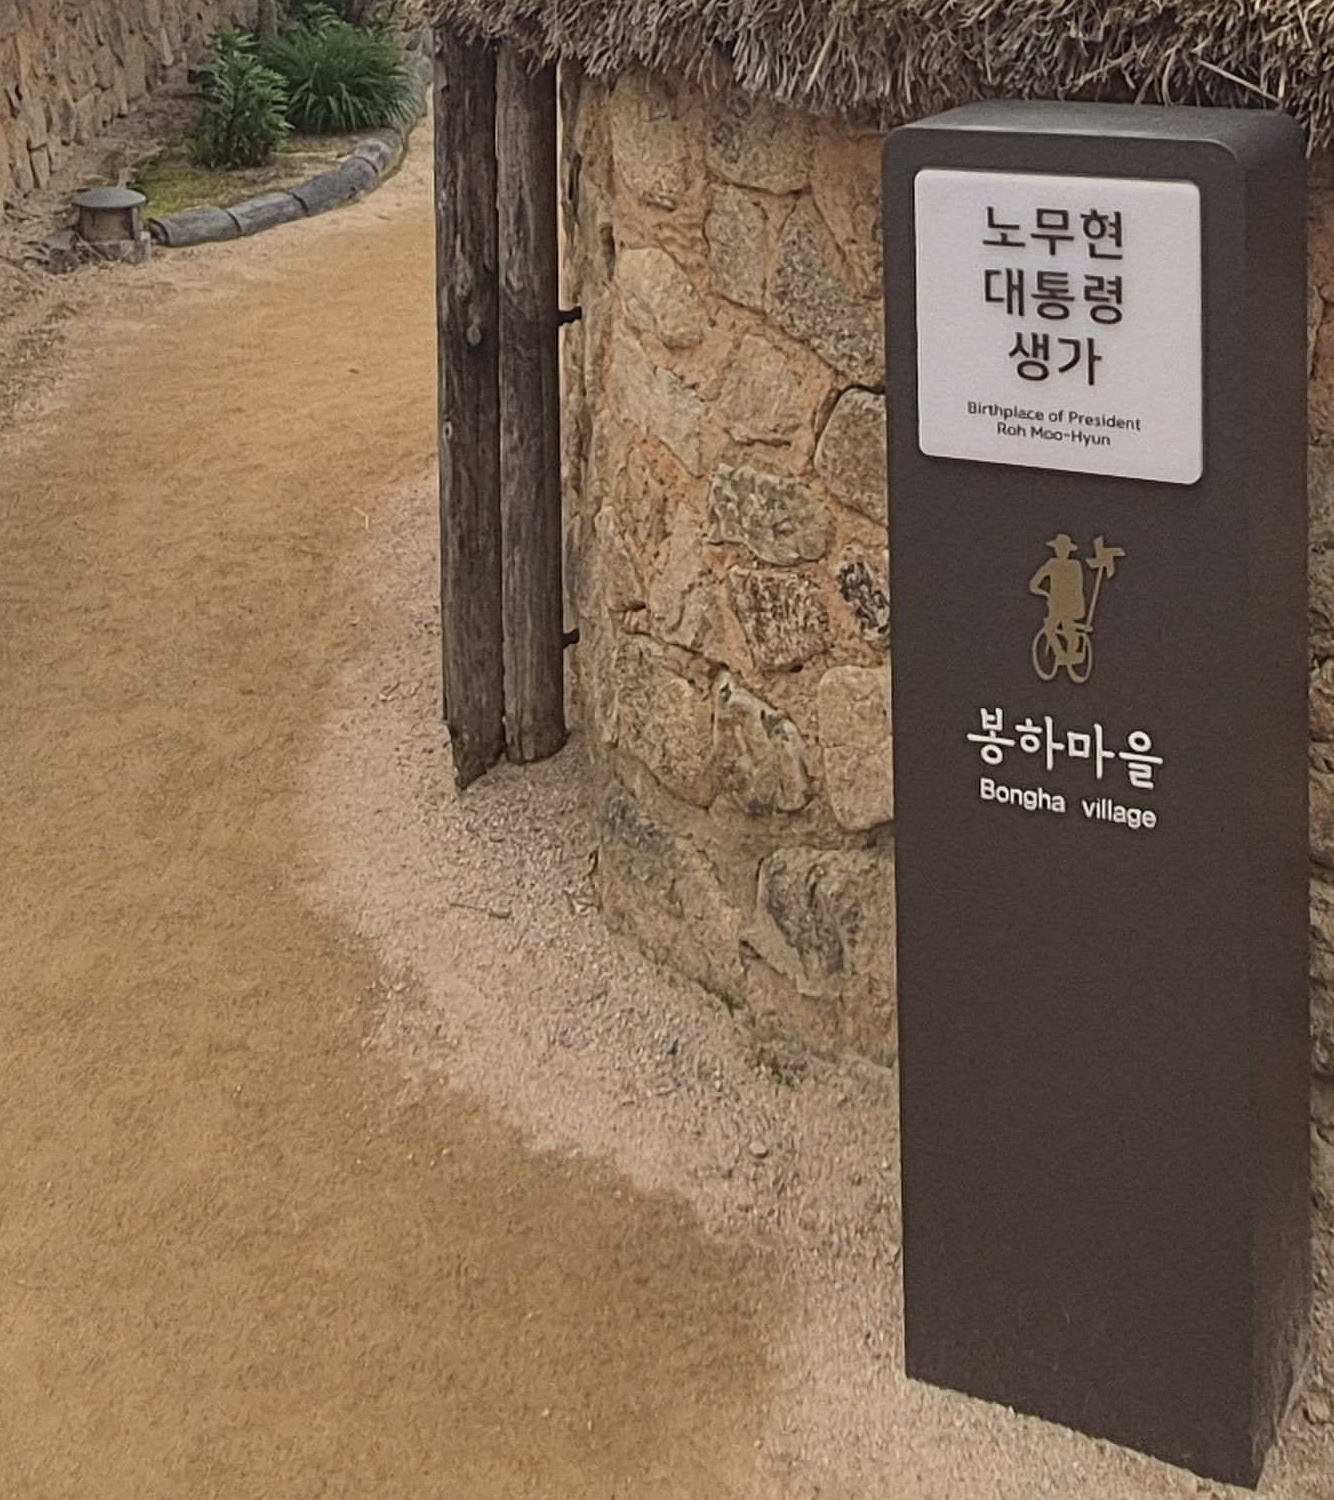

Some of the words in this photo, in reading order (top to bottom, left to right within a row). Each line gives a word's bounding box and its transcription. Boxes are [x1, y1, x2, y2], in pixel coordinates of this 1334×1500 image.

[982, 205, 1124, 261] 노무현
[984, 267, 1124, 326] 대통령
[1008, 331, 1103, 387] 생가
[967, 400, 1044, 421] Birthplace
[1048, 409, 1064, 423] of
[1068, 411, 1141, 432] President
[997, 421, 1026, 438] Roh
[1030, 425, 1111, 447] Moo-Hyun
[967, 707, 1164, 790] 봉하마을
[980, 777, 1066, 813] Bongha
[1081, 798, 1157, 829] village
